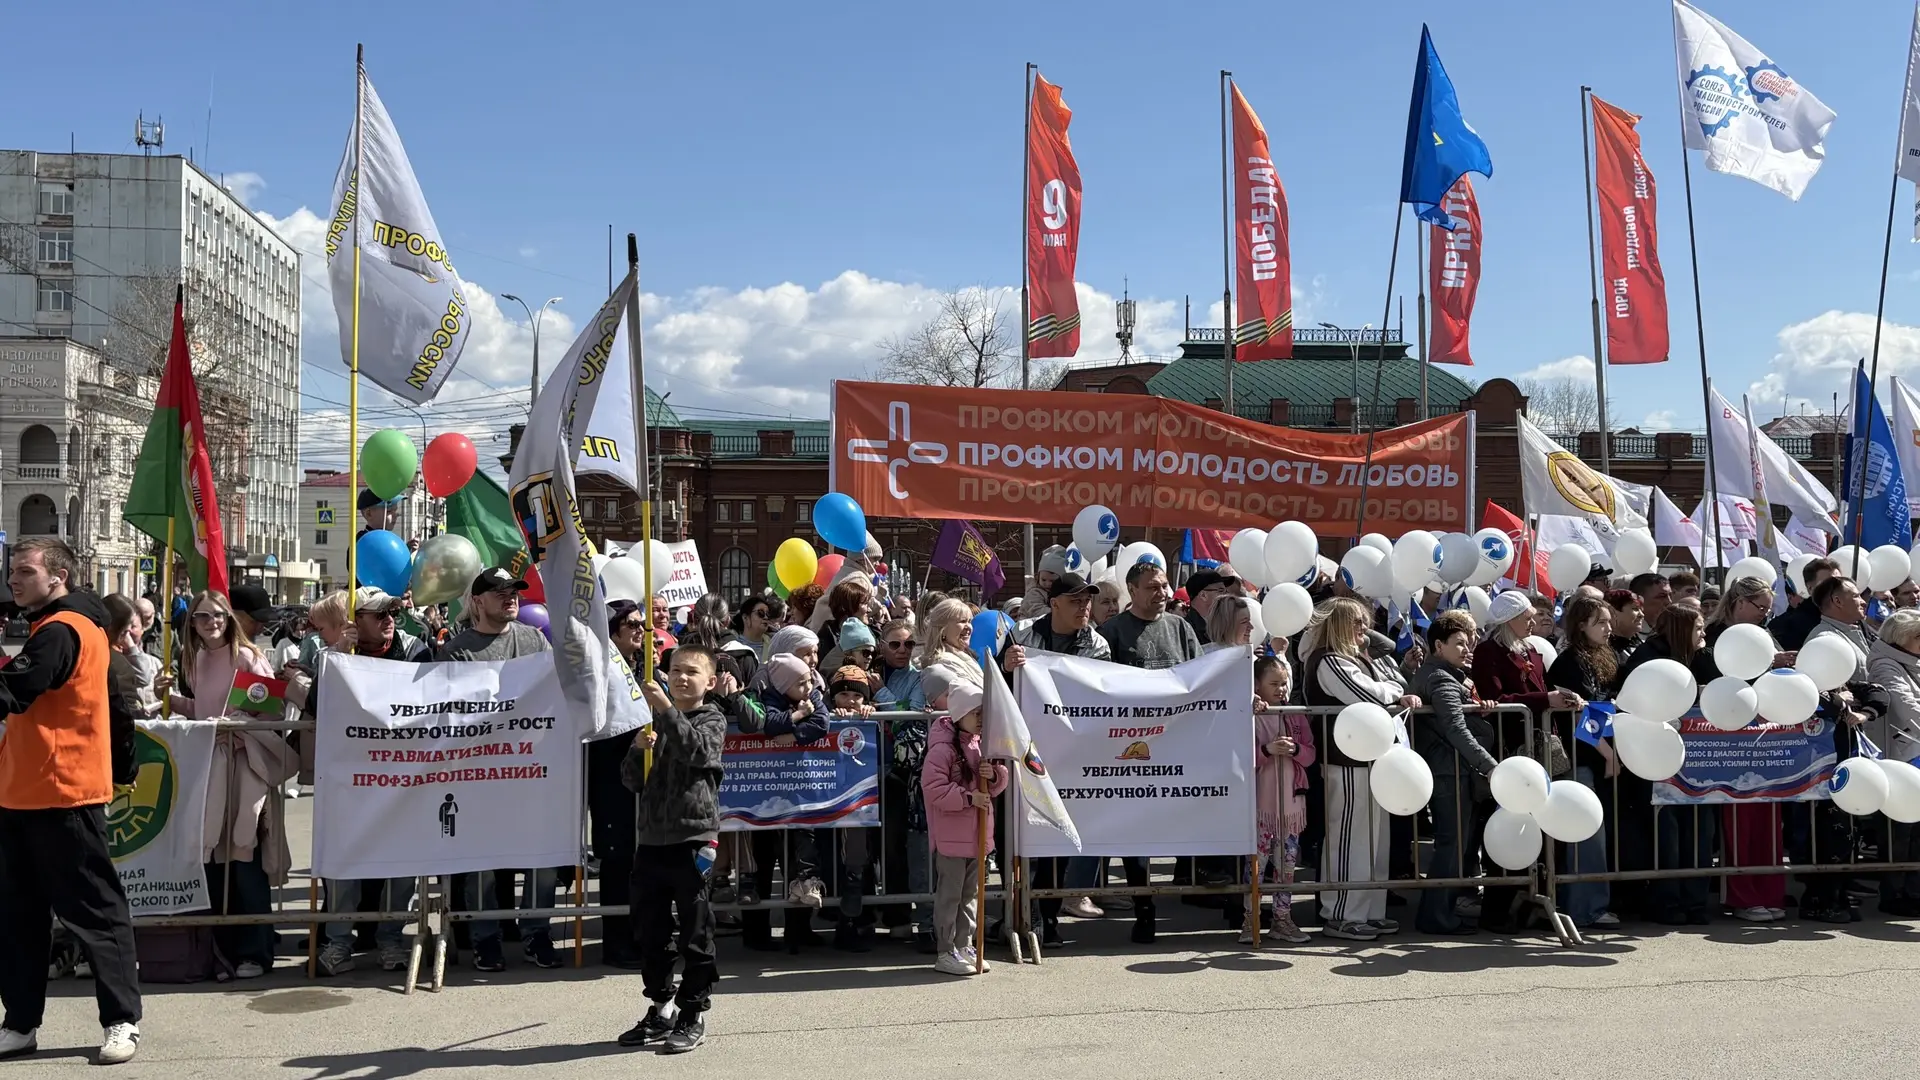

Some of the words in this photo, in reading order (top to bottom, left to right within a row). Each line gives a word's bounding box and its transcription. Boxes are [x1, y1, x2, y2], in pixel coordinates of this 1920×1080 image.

[1699, 78, 1724, 92] СОЮЗ
[1693, 101, 1722, 117] РОССИИ
[1695, 89, 1787, 131] МАШИНОСТРОИТЕЛЕЙ
[1043, 179, 1067, 229] 9
[1248, 156, 1278, 281] ПОБЕДА!
[1623, 205, 1641, 271] ТРУДОВОЙ
[1614, 277, 1629, 319] ГОРОД
[958, 404, 1123, 434] ПРОФКОМ
[958, 441, 1123, 471] ПРОФКОМ
[1133, 448, 1328, 485] МОЛОДОСТЬ
[1335, 463, 1459, 487] ЛЮБОВЬ
[958, 477, 1122, 507] ПРОФКОМ
[1130, 484, 1325, 519] МОЛОДОСТЬ
[1331, 497, 1459, 522] ЛЮБОВЬ
[390, 699, 515, 717] УВЕЛИЧЕНИЕ
[1043, 703, 1114, 718] ГОРНЯКИ
[1117, 705, 1129, 718] И
[1132, 699, 1228, 719] МЕТАЛЛУРГИ
[345, 721, 492, 740] СВЕРХУРОЧНОЙ
[508, 716, 556, 731] РОСТ
[1108, 725, 1165, 739] ПРОТИВ
[368, 742, 513, 763] ТРАВМАТИЗМА
[518, 741, 533, 755] И
[740, 740, 763, 751] ДЕНЬ
[1685, 740, 1730, 748] ПРОФСОЮЗЫ
[1713, 750, 1745, 759] ДИАЛОГЕ
[721, 761, 737, 770] РИЯ
[739, 760, 785, 769] ПЕРВОМАЯ
[796, 759, 836, 768] ИСТОРИЯ
[1082, 764, 1184, 778] УВЕЛИЧЕНИЯ
[353, 763, 548, 787] ПРОФЗАБОЛЕВАНИЙ!
[734, 772, 745, 780] ЗА
[747, 772, 779, 780] ПРАВА.
[780, 770, 837, 780] ПРОДОЛЖИМ
[740, 784, 763, 793] ДУХЕ
[764, 782, 837, 792] СОЛИДАРНОСТИ!
[1058, 783, 1158, 800] ЕРХУРОЧНОЙ
[1161, 785, 1229, 798] РАБОТЫ!
[119, 868, 146, 881] НАЯ
[173, 893, 194, 906] ГАУ
